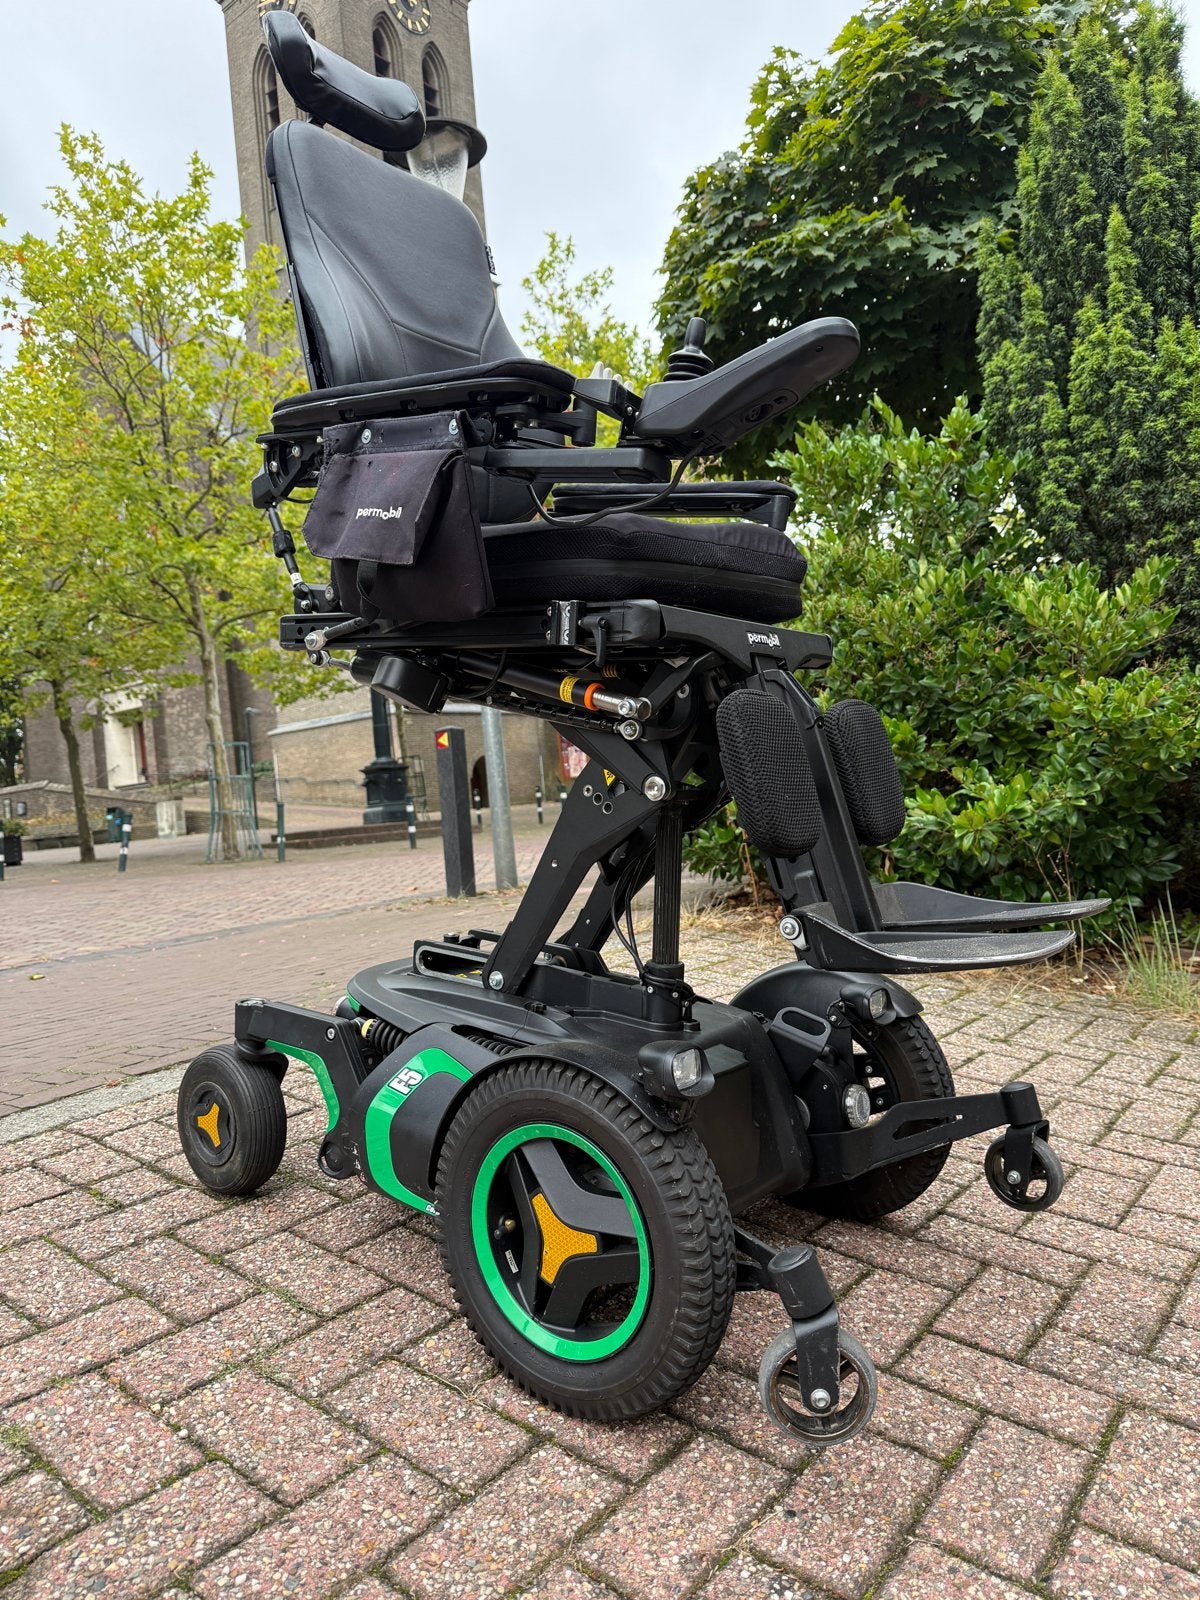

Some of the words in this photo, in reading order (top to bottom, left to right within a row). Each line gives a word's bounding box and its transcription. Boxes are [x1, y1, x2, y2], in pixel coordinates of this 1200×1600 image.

[355, 506, 403, 520] permobil
[747, 632, 781, 647] permobil
[388, 1067, 423, 1096] F5
